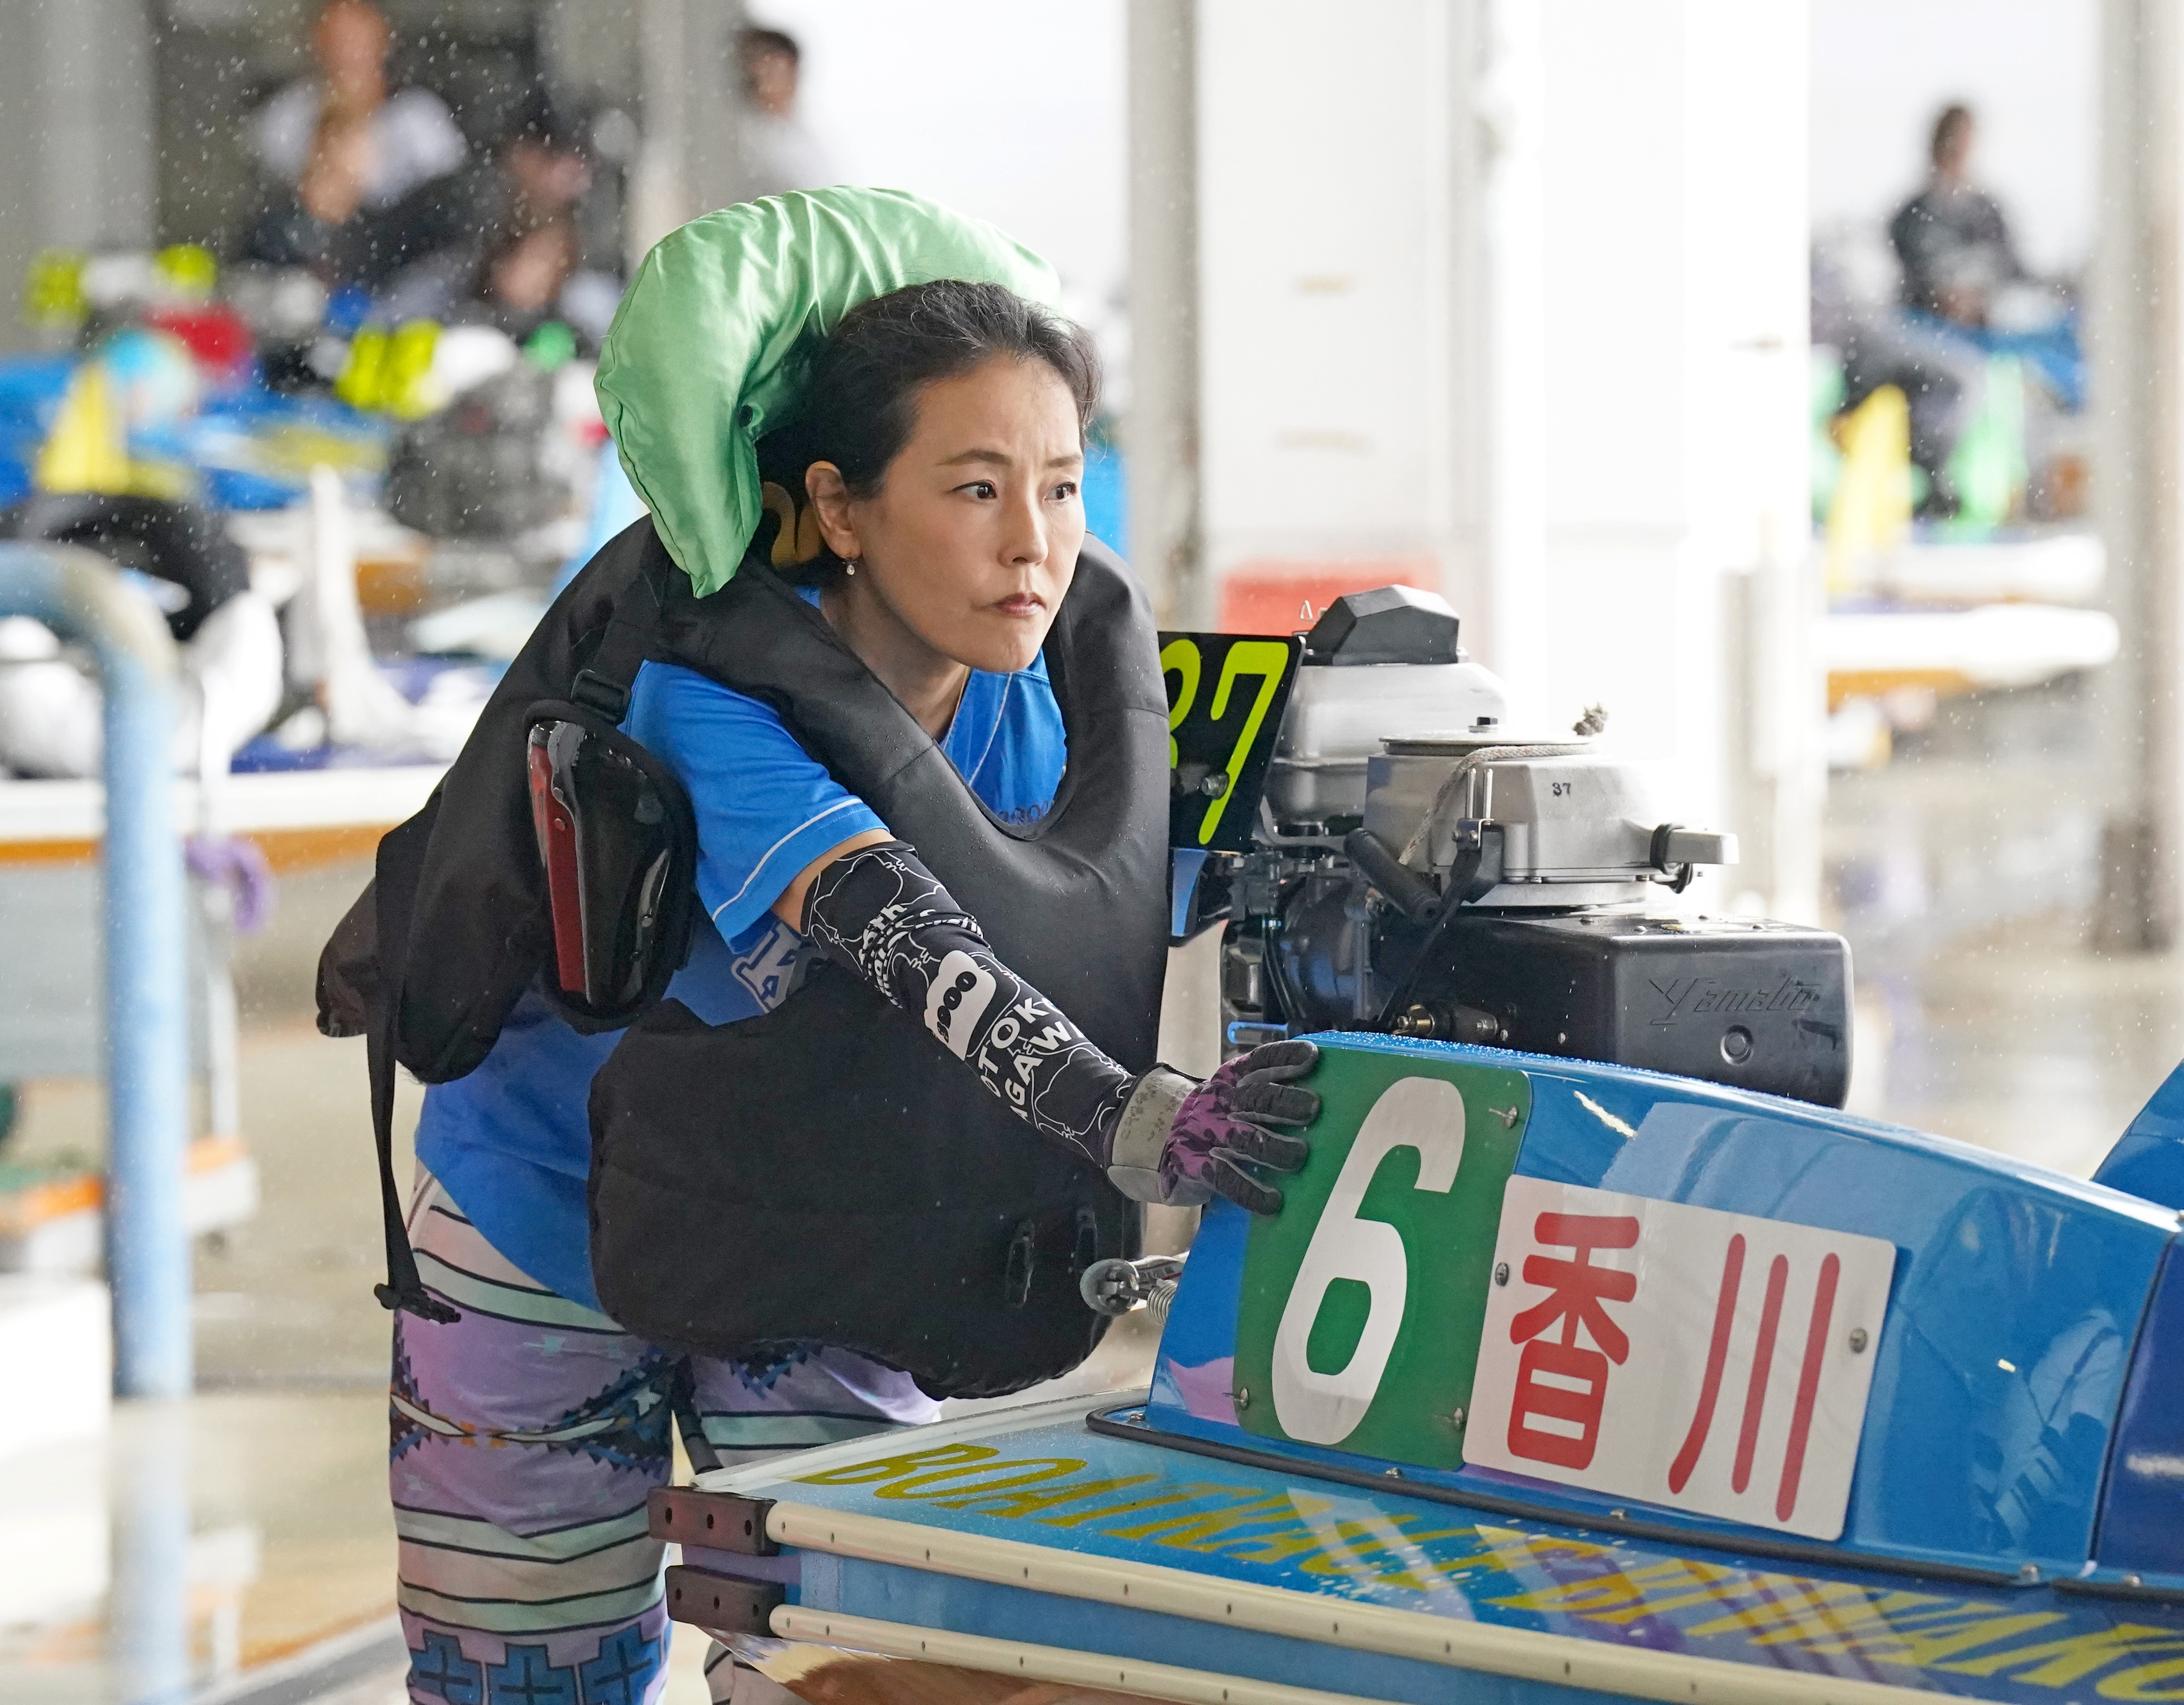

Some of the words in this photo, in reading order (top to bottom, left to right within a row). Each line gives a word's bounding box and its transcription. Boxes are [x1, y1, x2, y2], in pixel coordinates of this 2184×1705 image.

[1552, 782, 1571, 796] 37
[1272, 1076, 1466, 1445] 6
[1509, 1211, 1840, 1522] 香川
